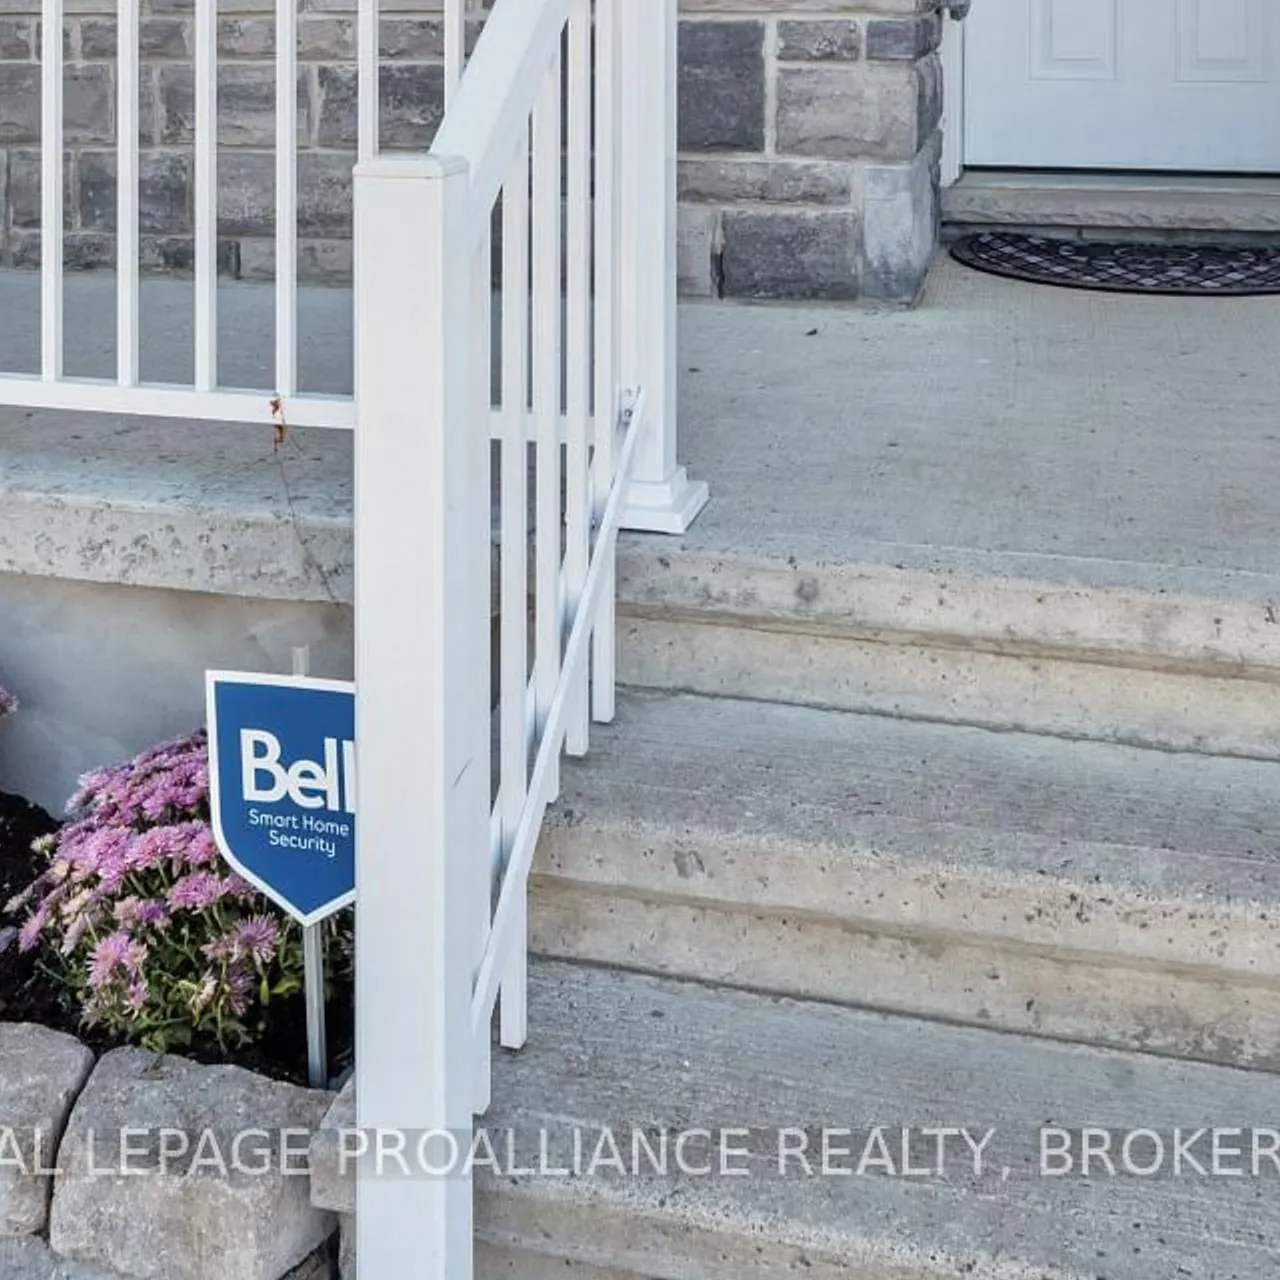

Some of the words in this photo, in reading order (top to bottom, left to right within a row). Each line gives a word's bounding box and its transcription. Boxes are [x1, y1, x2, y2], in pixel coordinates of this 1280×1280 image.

[240, 728, 355, 813] Bell
[249, 809, 300, 829] Smart
[303, 815, 349, 836] Home
[270, 830, 336, 857] Security
